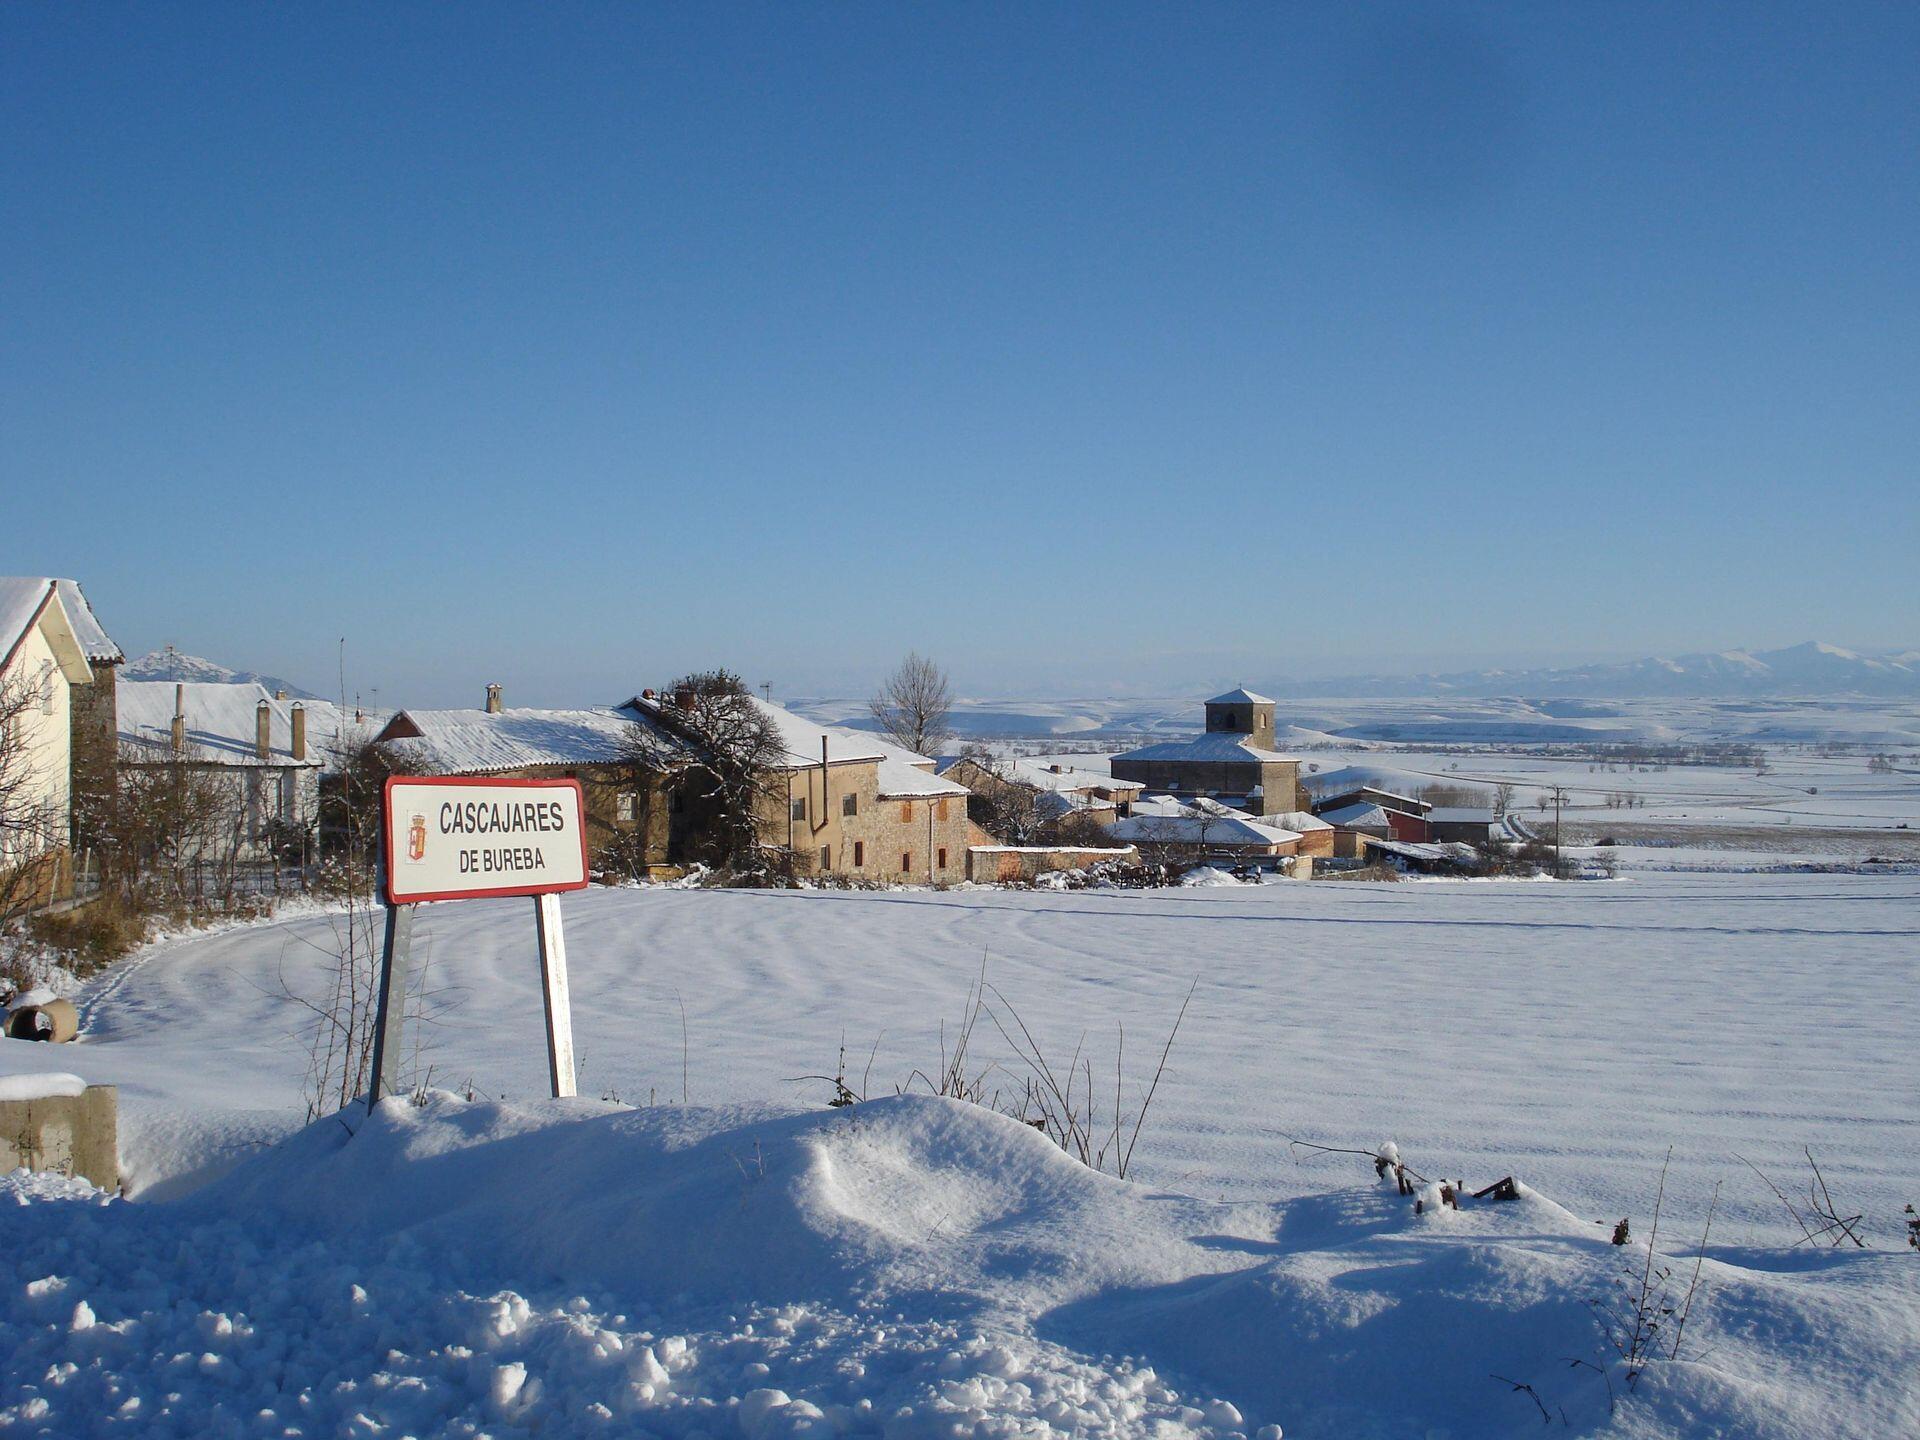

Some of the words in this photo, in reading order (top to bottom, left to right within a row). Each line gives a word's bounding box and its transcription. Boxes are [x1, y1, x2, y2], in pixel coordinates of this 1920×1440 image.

[440, 802, 564, 834] CASCAJARES
[460, 849, 479, 873] DE
[484, 847, 545, 871] BUREBA
